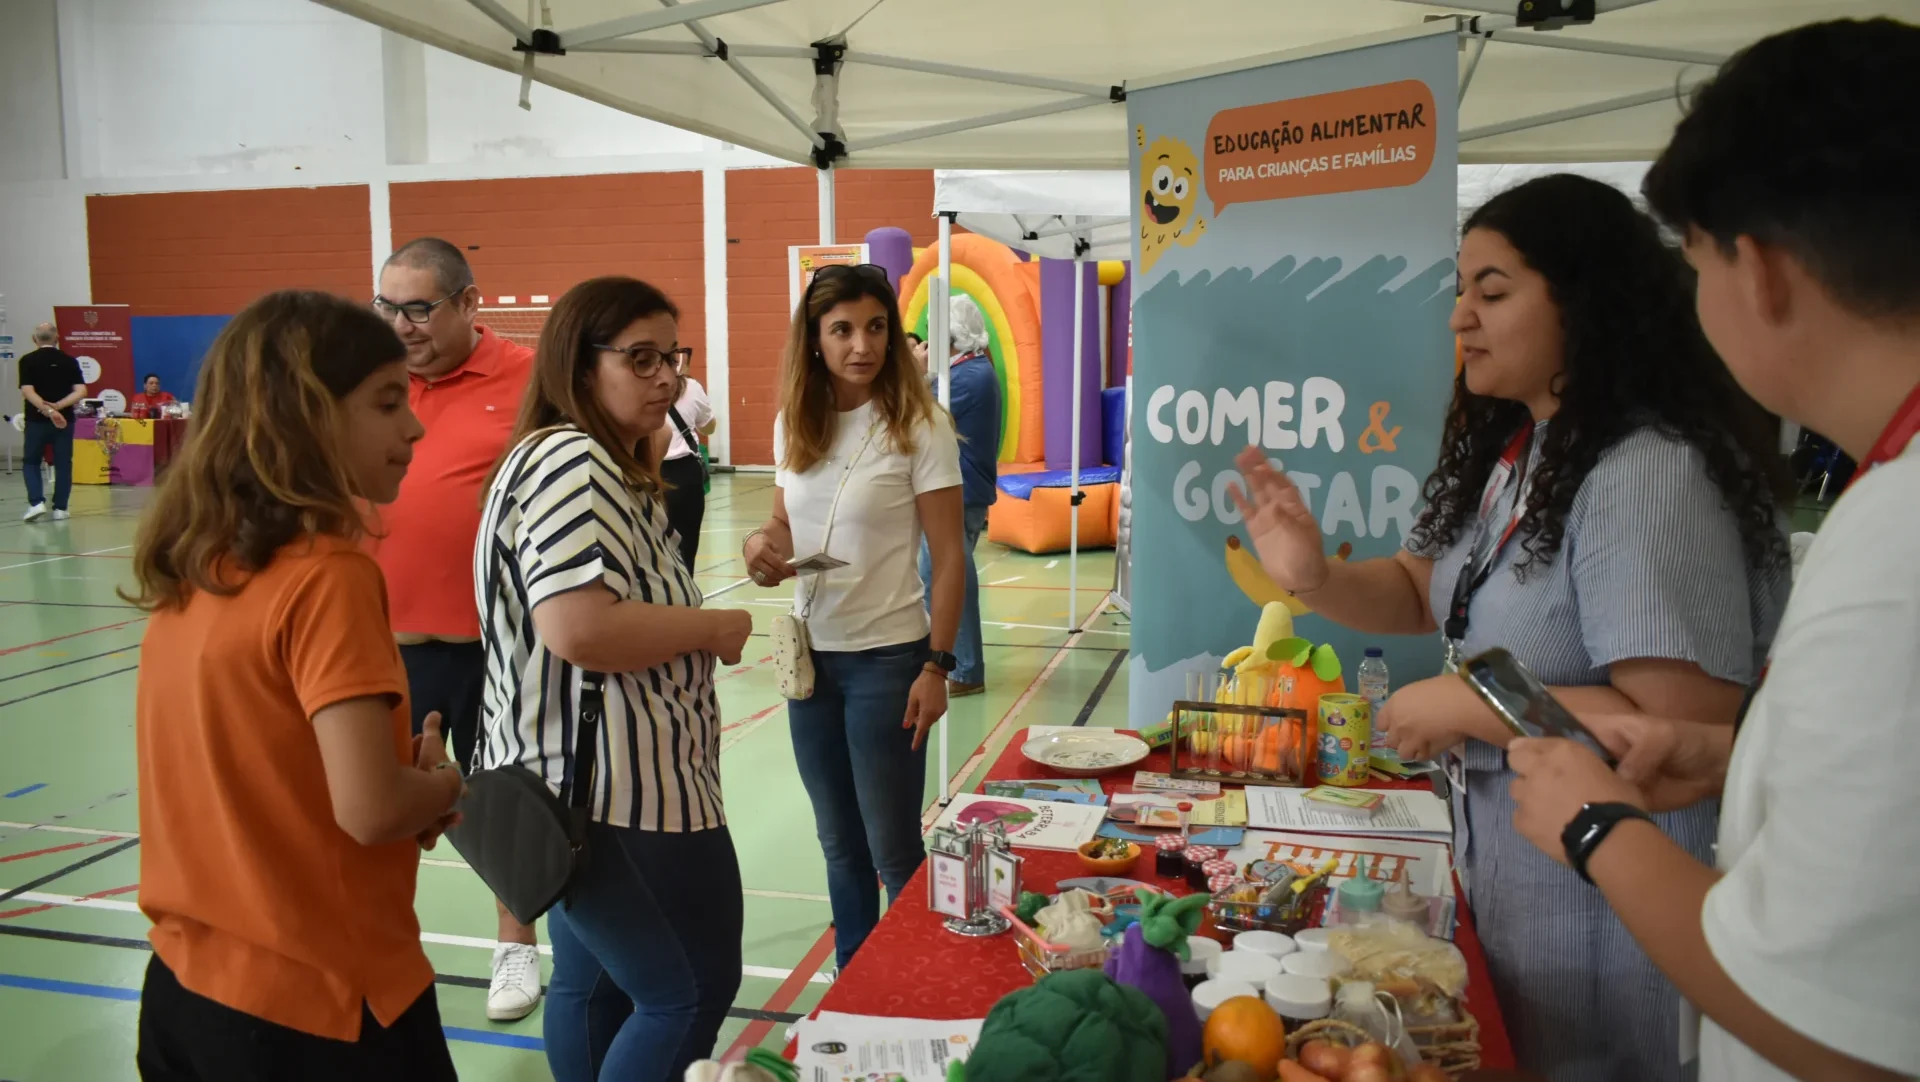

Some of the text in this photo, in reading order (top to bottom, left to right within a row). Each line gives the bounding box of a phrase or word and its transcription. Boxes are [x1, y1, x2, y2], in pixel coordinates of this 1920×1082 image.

[1213, 103, 1426, 155] EDUCAÇÃO ALIMENTAR
[1218, 143, 1417, 183] PARA CRIANÇAS E FAMÍLIAS
[1146, 376, 1403, 454] COMER &
[1173, 457, 1420, 539] GOTAR
[1016, 805, 1054, 839] BETERRABA
